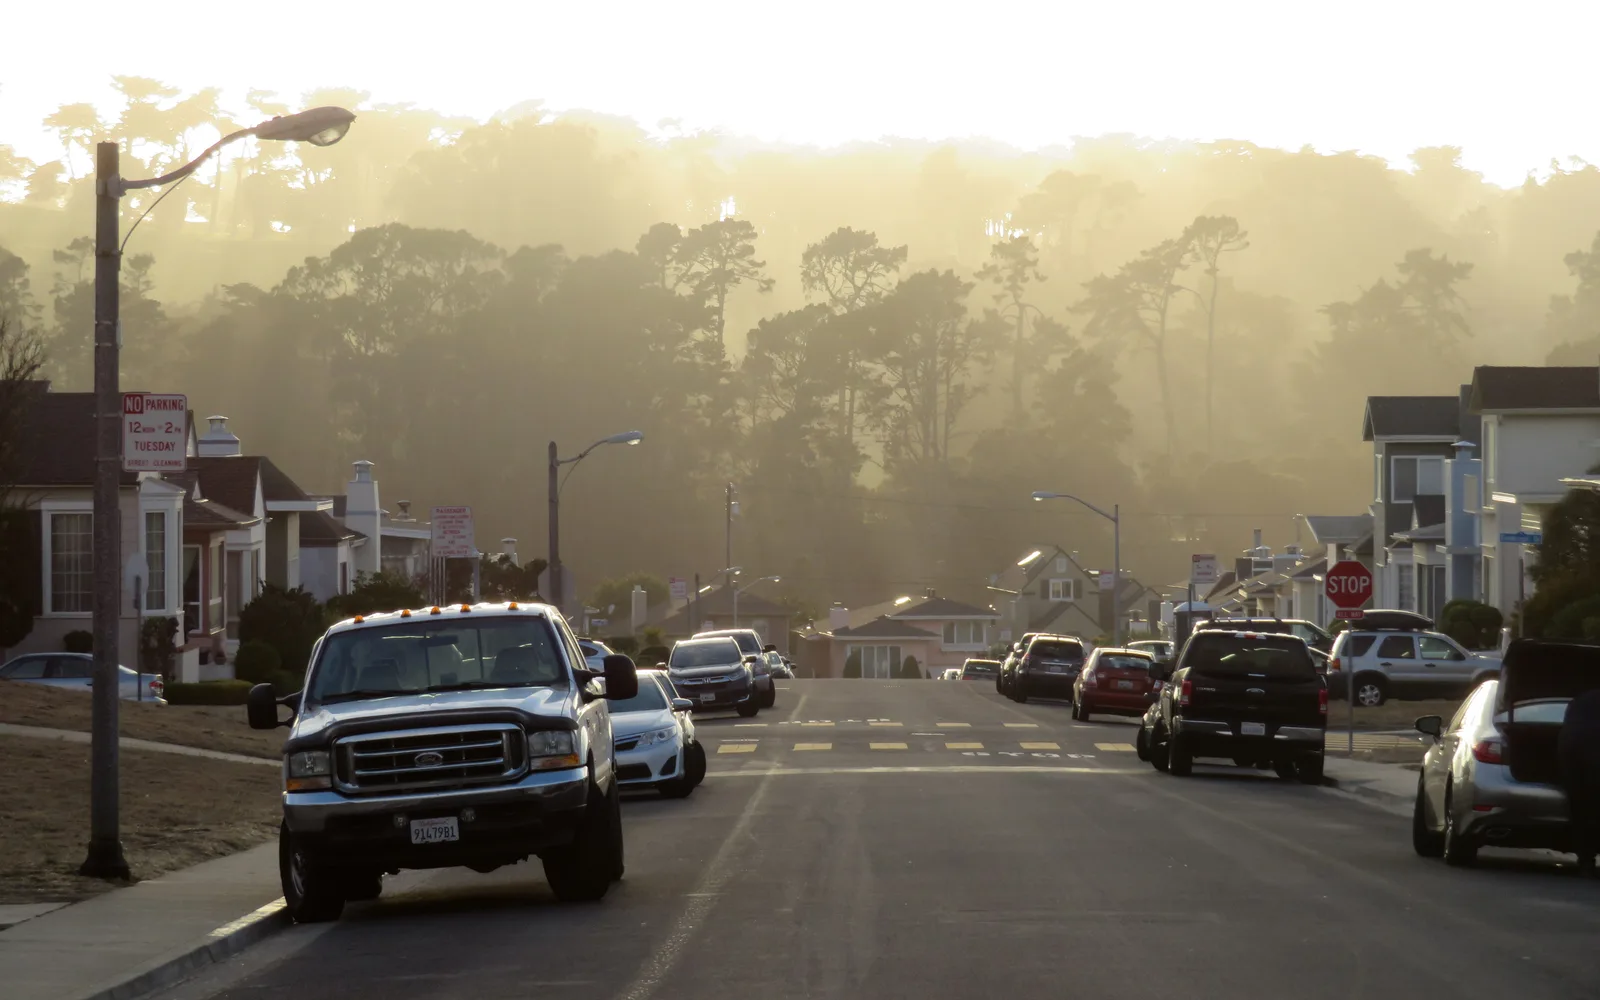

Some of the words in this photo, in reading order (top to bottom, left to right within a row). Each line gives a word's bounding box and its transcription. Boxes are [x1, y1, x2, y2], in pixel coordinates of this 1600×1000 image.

[126, 396, 142, 412] NO
[146, 399, 184, 411] PARKING
[129, 422, 141, 433] 12
[165, 422, 173, 433] 2
[135, 441, 176, 451] TUESDAY
[1328, 575, 1370, 594] STOP
[414, 826, 456, 840] 91479B1
